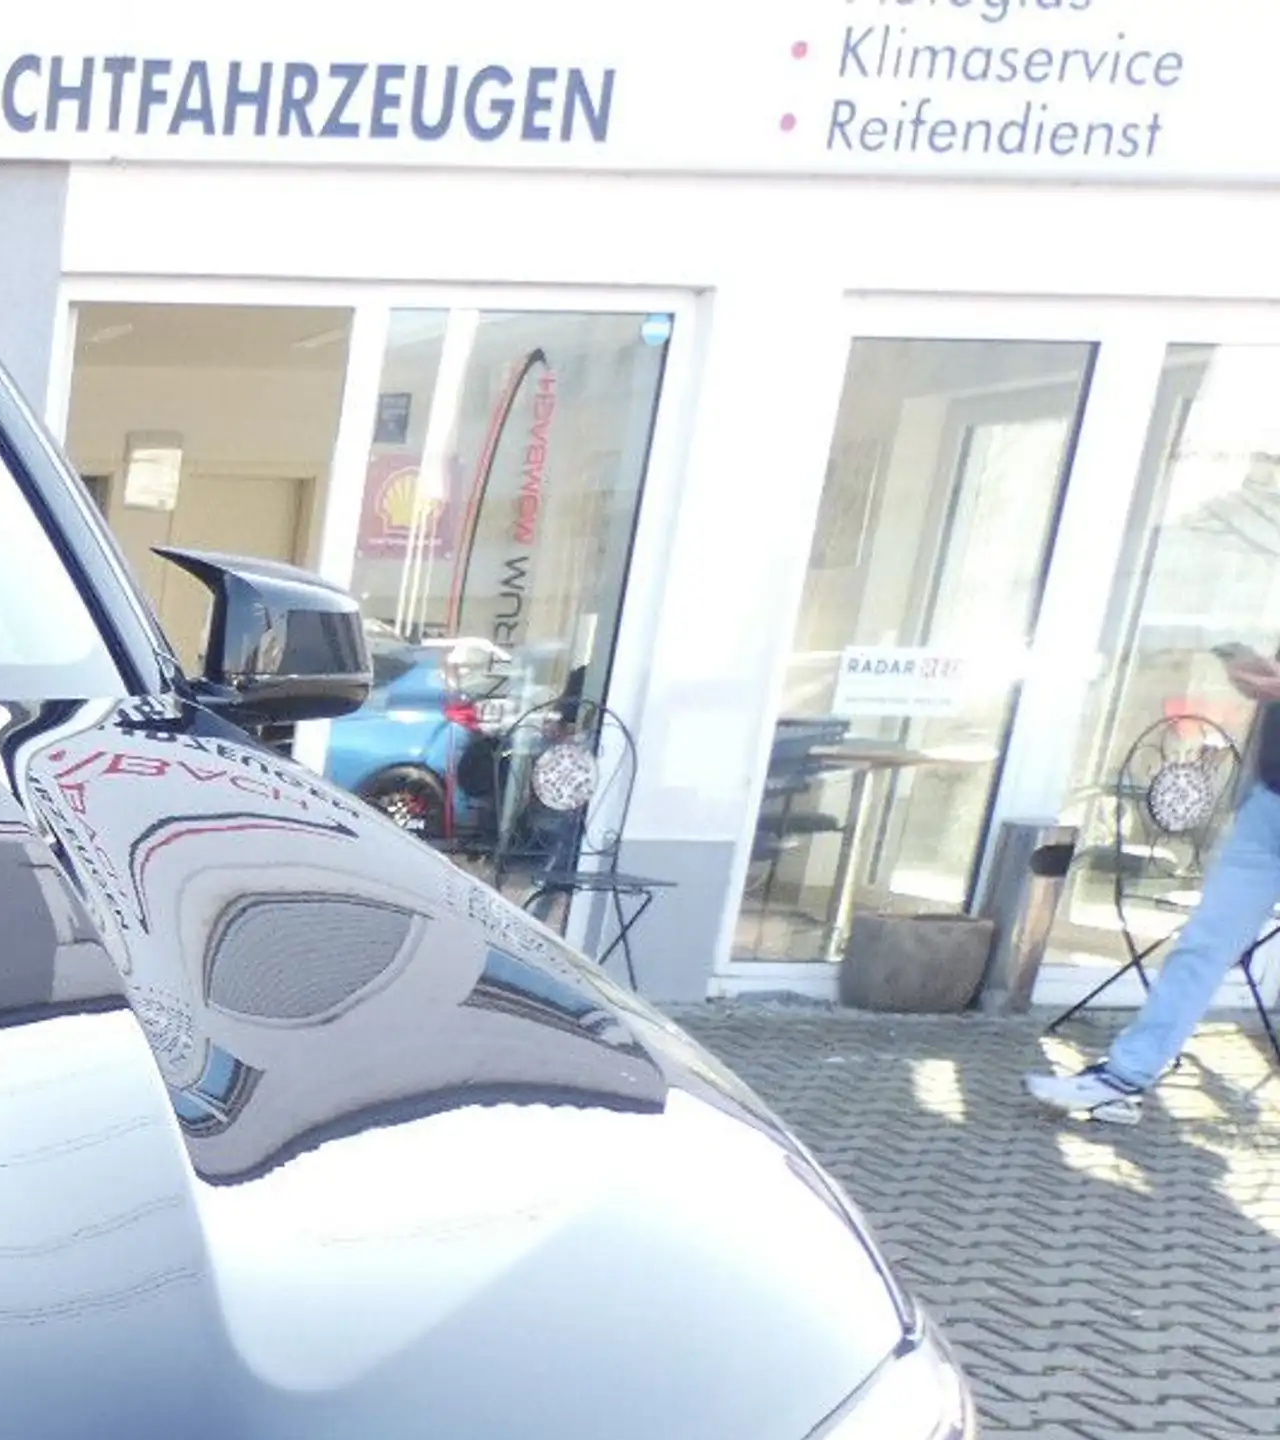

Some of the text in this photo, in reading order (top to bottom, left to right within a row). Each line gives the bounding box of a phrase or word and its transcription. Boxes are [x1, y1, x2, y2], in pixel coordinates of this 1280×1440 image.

[838, 25, 1185, 87] Klimaservice
[826, 98, 1163, 158] Reifendienst
[847, 657, 916, 677] RADAR
